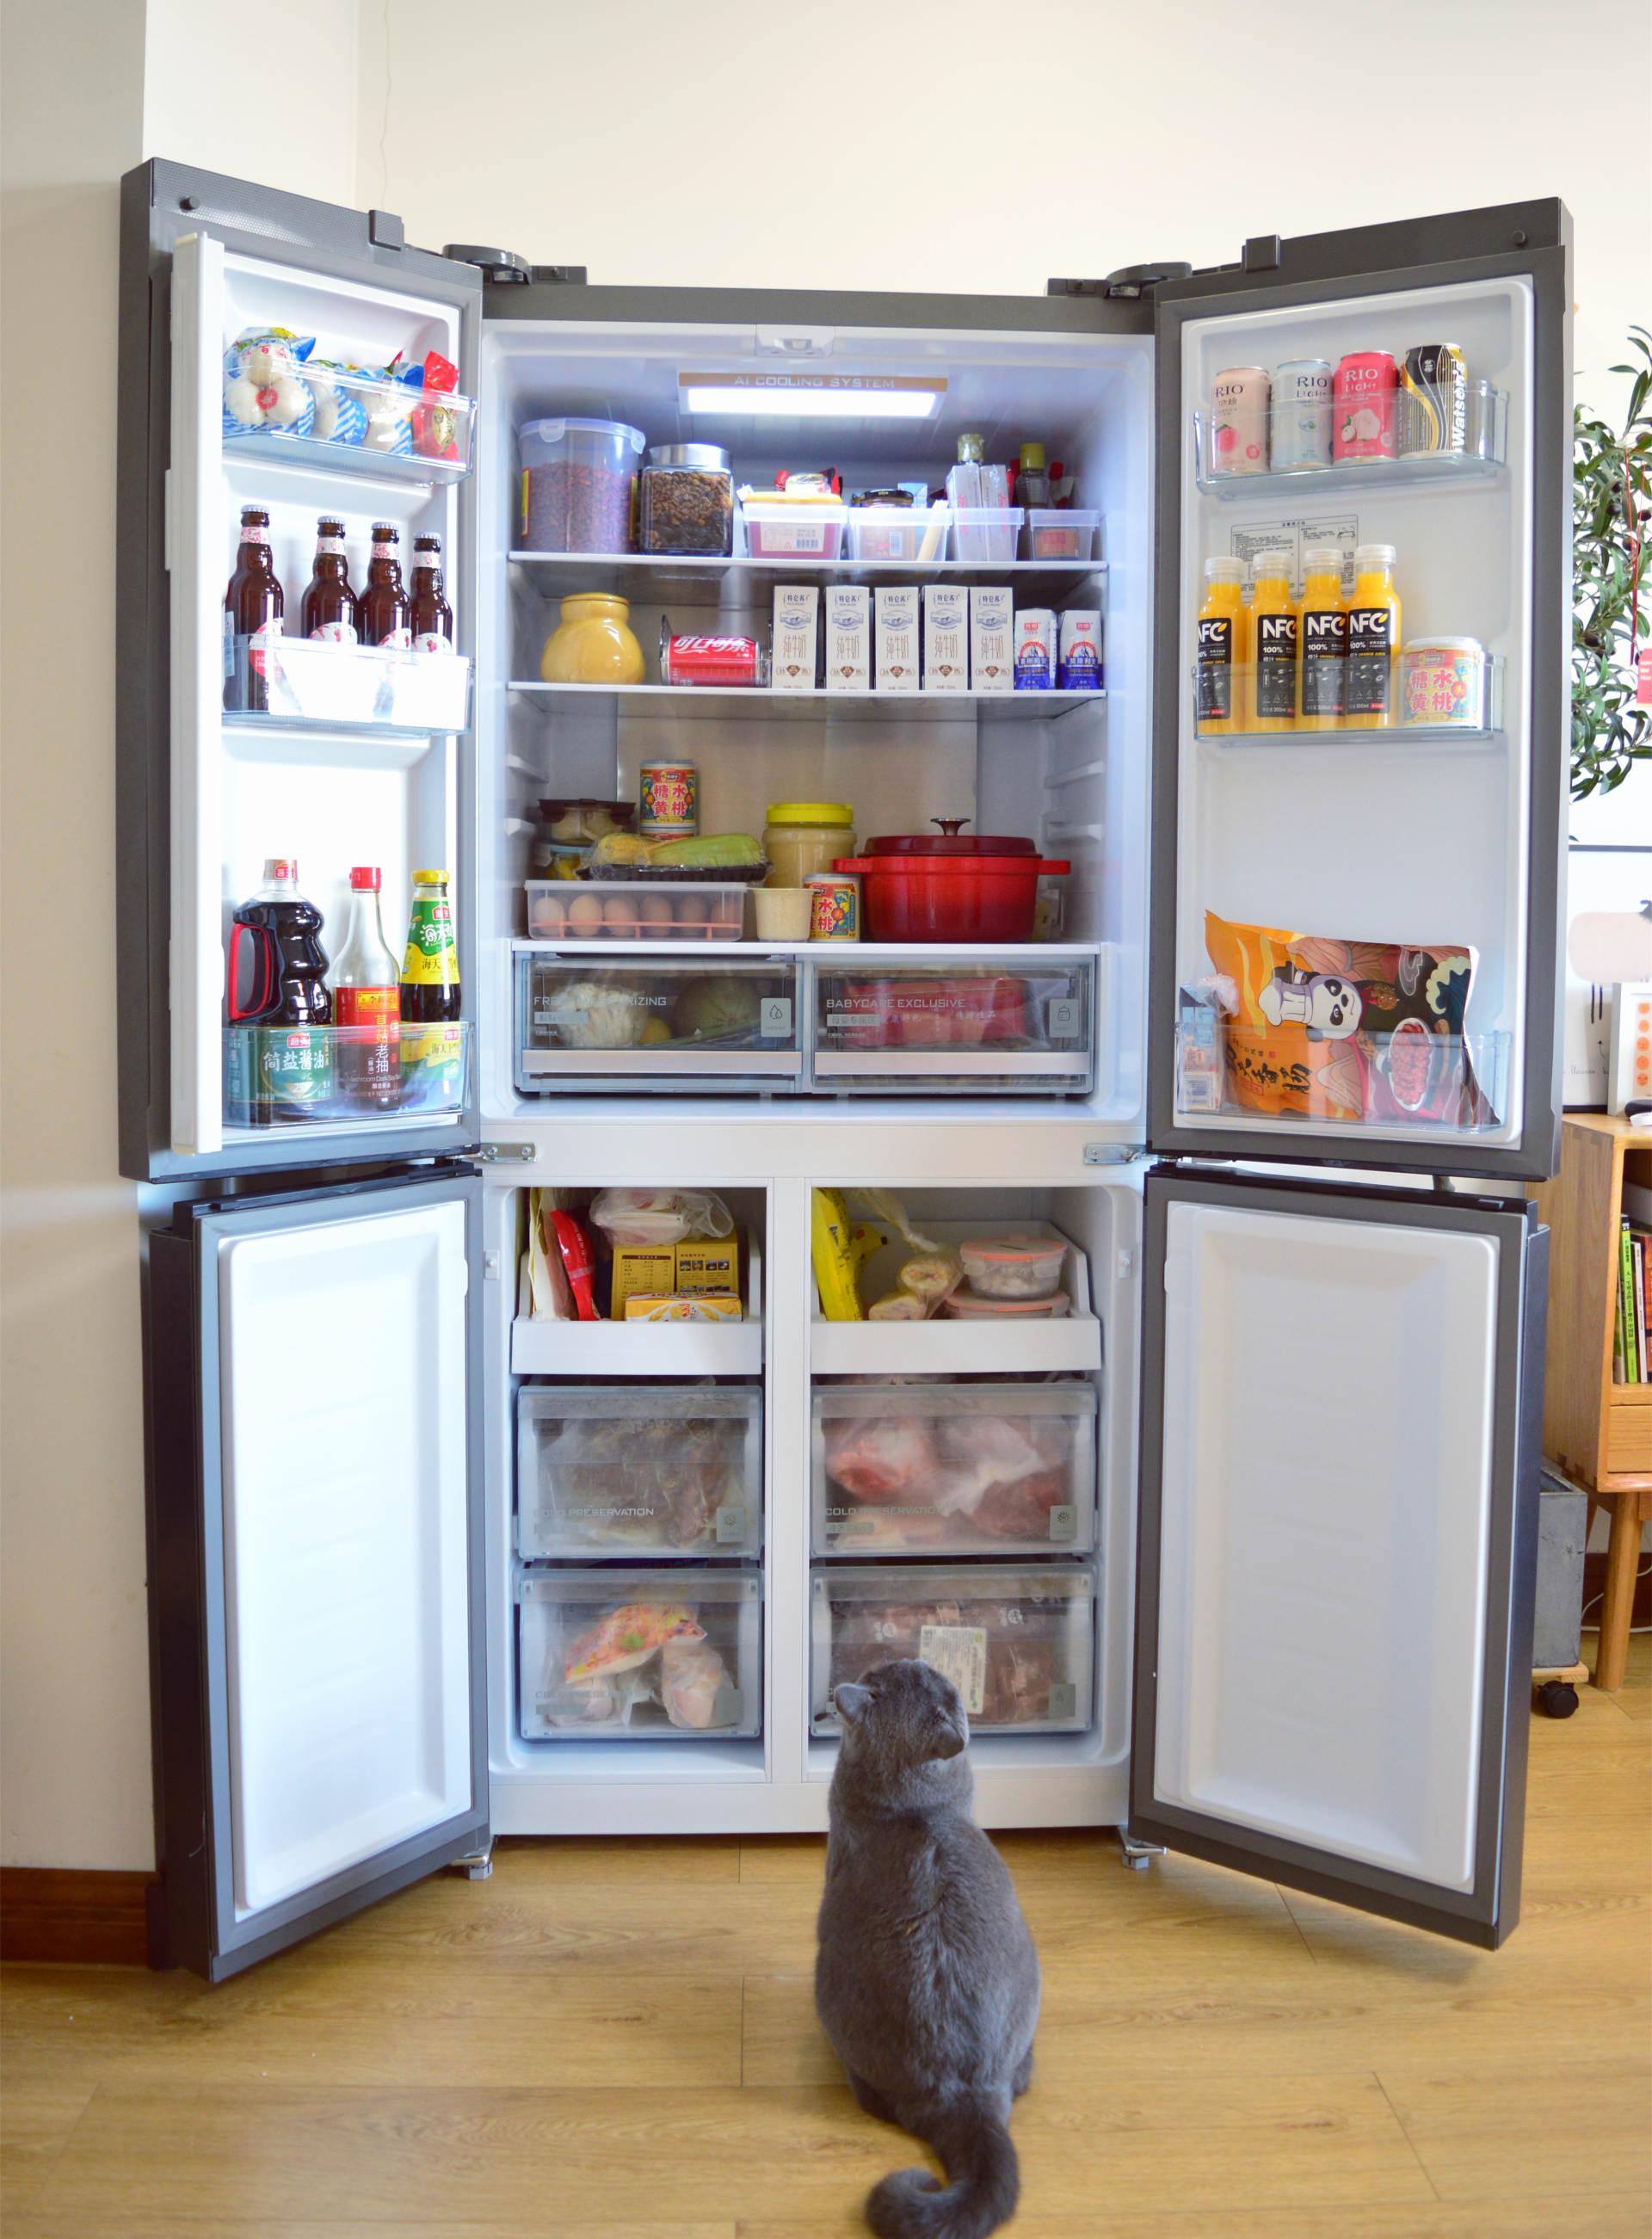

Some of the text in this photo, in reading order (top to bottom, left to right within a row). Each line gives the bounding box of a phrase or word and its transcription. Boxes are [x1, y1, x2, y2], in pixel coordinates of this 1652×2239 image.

[734, 376, 896, 388] AI COOLING SYSTEM
[1297, 376, 1328, 388] RIO
[1346, 368, 1378, 382] RIO
[1215, 384, 1244, 398] RIO
[1452, 361, 1466, 447] Watson's
[1262, 619, 1297, 639] NFC
[1308, 615, 1344, 636] NFC
[1349, 613, 1385, 634] NFC
[674, 636, 750, 654] 可口可乐
[1411, 669, 1453, 689] 糖水
[1411, 691, 1453, 712] 黄桃
[654, 784, 686, 799] 糖水
[654, 800, 687, 816] 黄桃
[826, 998, 966, 1008] BABYCARE EXCLUSIVE
[263, 1049, 325, 1071] 简盐酱油
[569, 1507, 654, 1517] PRESERVATION
[826, 1507, 857, 1515] COLD
